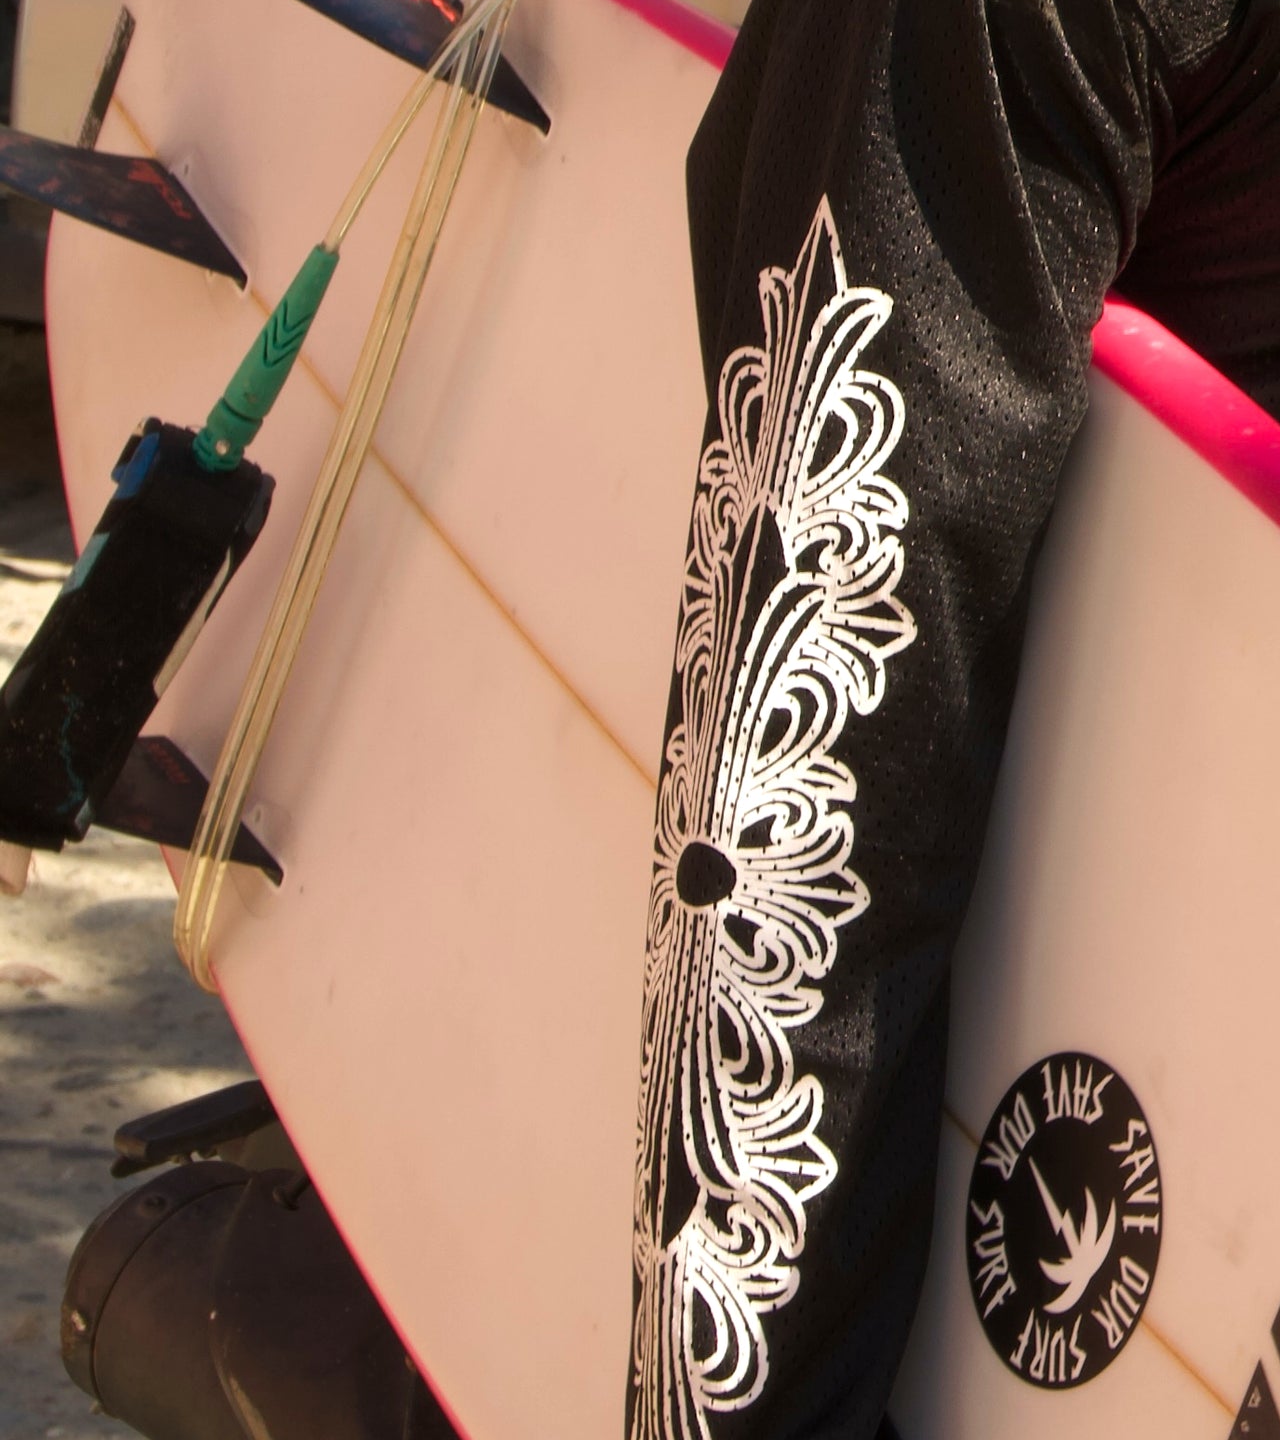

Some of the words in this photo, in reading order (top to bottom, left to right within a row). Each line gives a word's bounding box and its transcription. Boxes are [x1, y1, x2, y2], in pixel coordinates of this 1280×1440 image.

[981, 1091, 1036, 1181] OUR
[1040, 1058, 1114, 1125] SAVE
[1108, 1118, 1160, 1236] SAVE
[970, 1198, 1017, 1321] SURF
[1091, 1255, 1150, 1351] OUR
[1009, 1307, 1088, 1383] SURF
